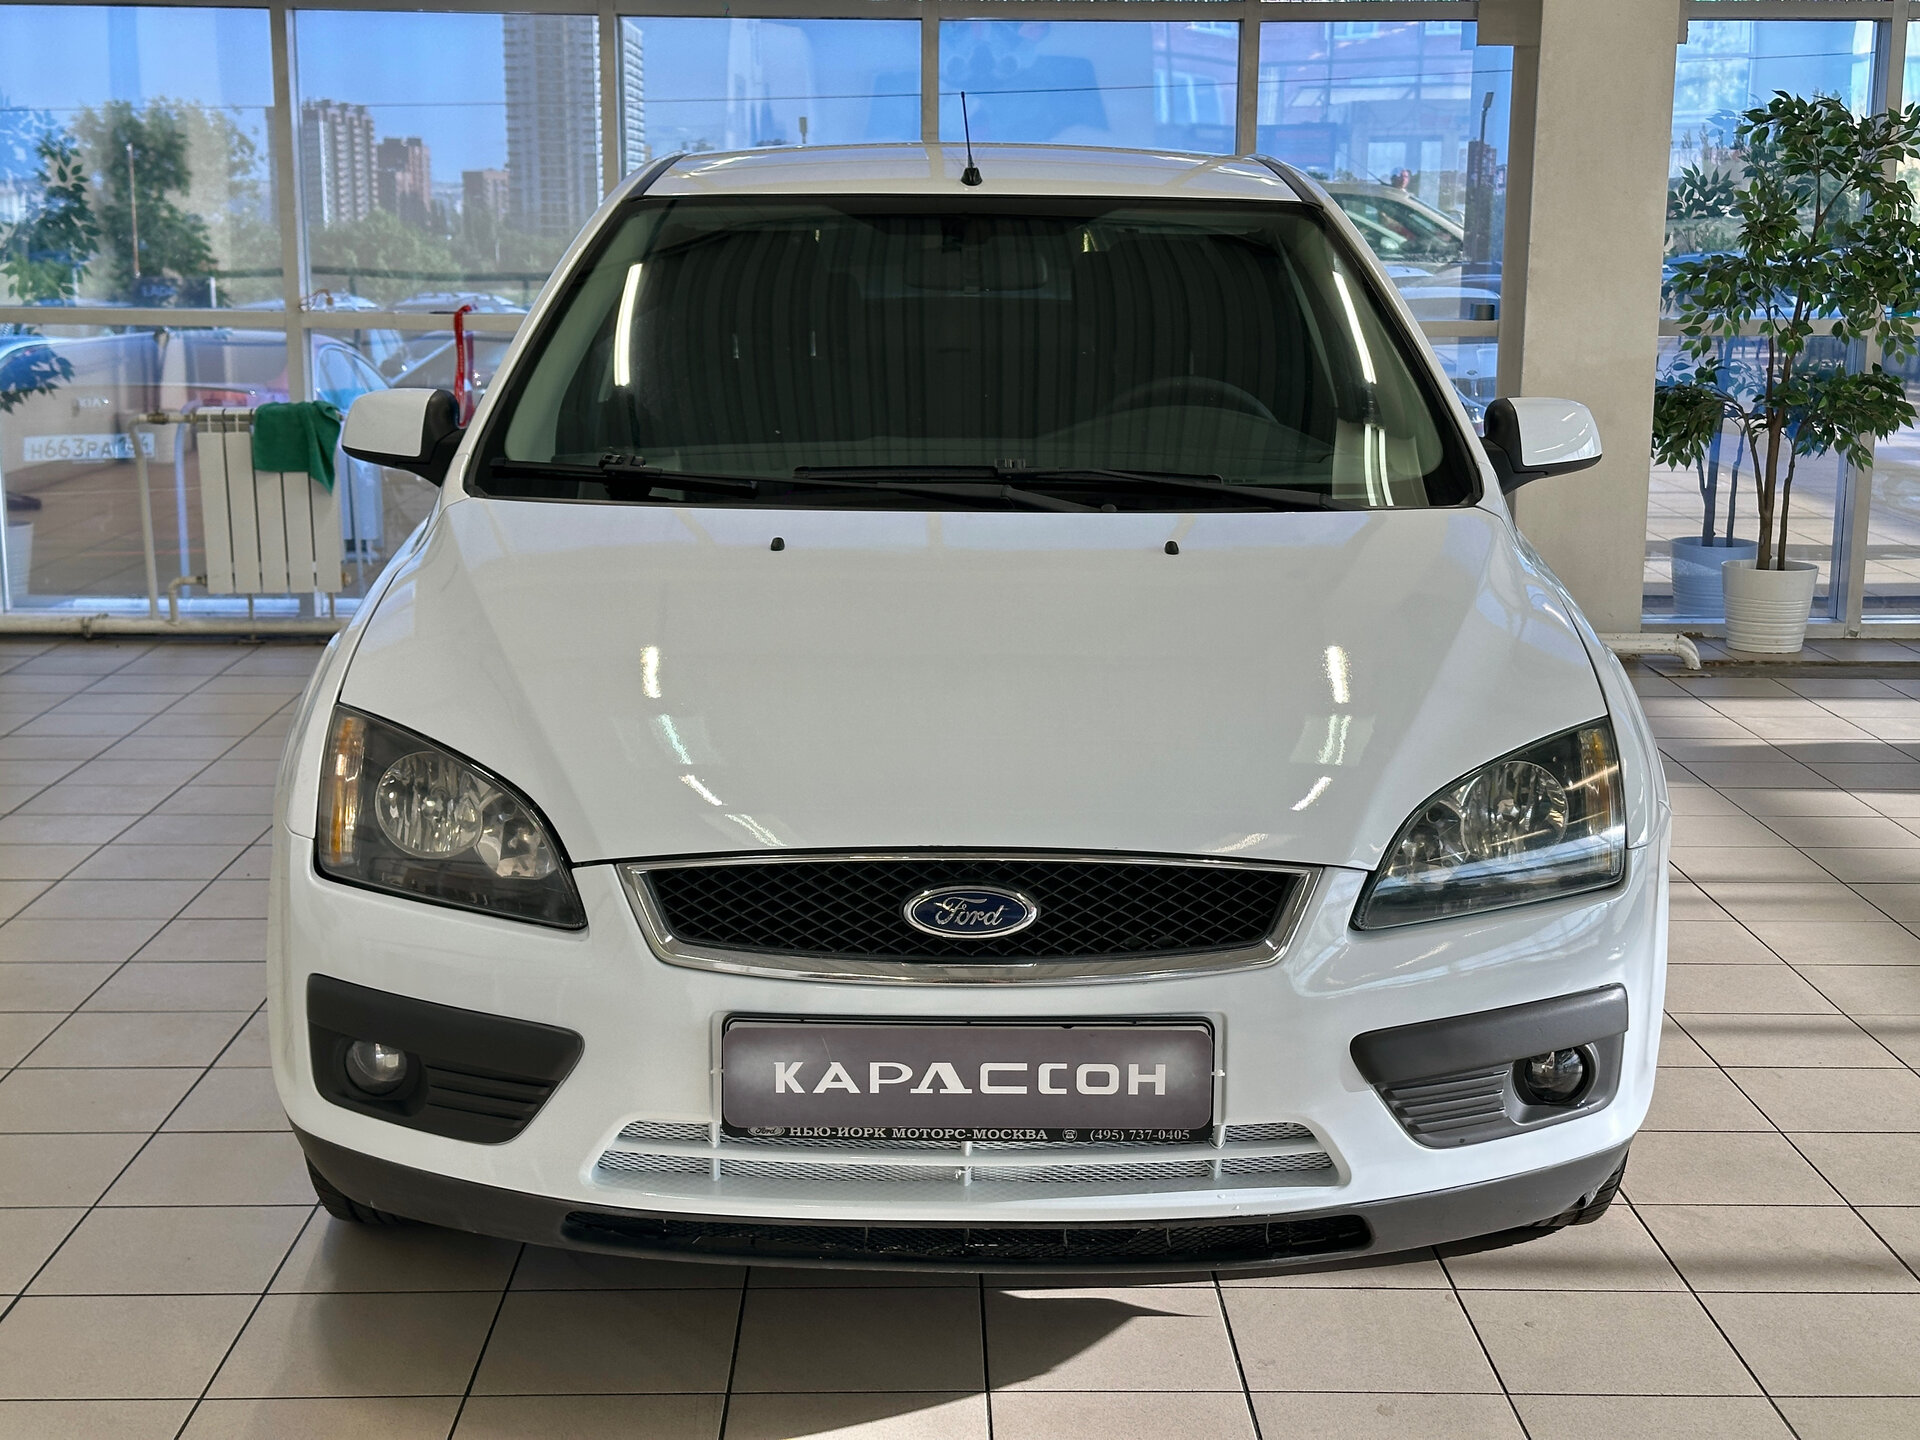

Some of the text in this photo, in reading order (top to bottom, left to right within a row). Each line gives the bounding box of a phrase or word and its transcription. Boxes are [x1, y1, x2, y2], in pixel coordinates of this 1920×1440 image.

[934, 896, 1009, 926] Ford
[773, 1061, 1166, 1096] КАРАССОН
[891, 1127, 1048, 1140] МОТОРС-МОСКВА
[1089, 1128, 1125, 1142] (495)
[1129, 1129, 1191, 1141] 737-0405
